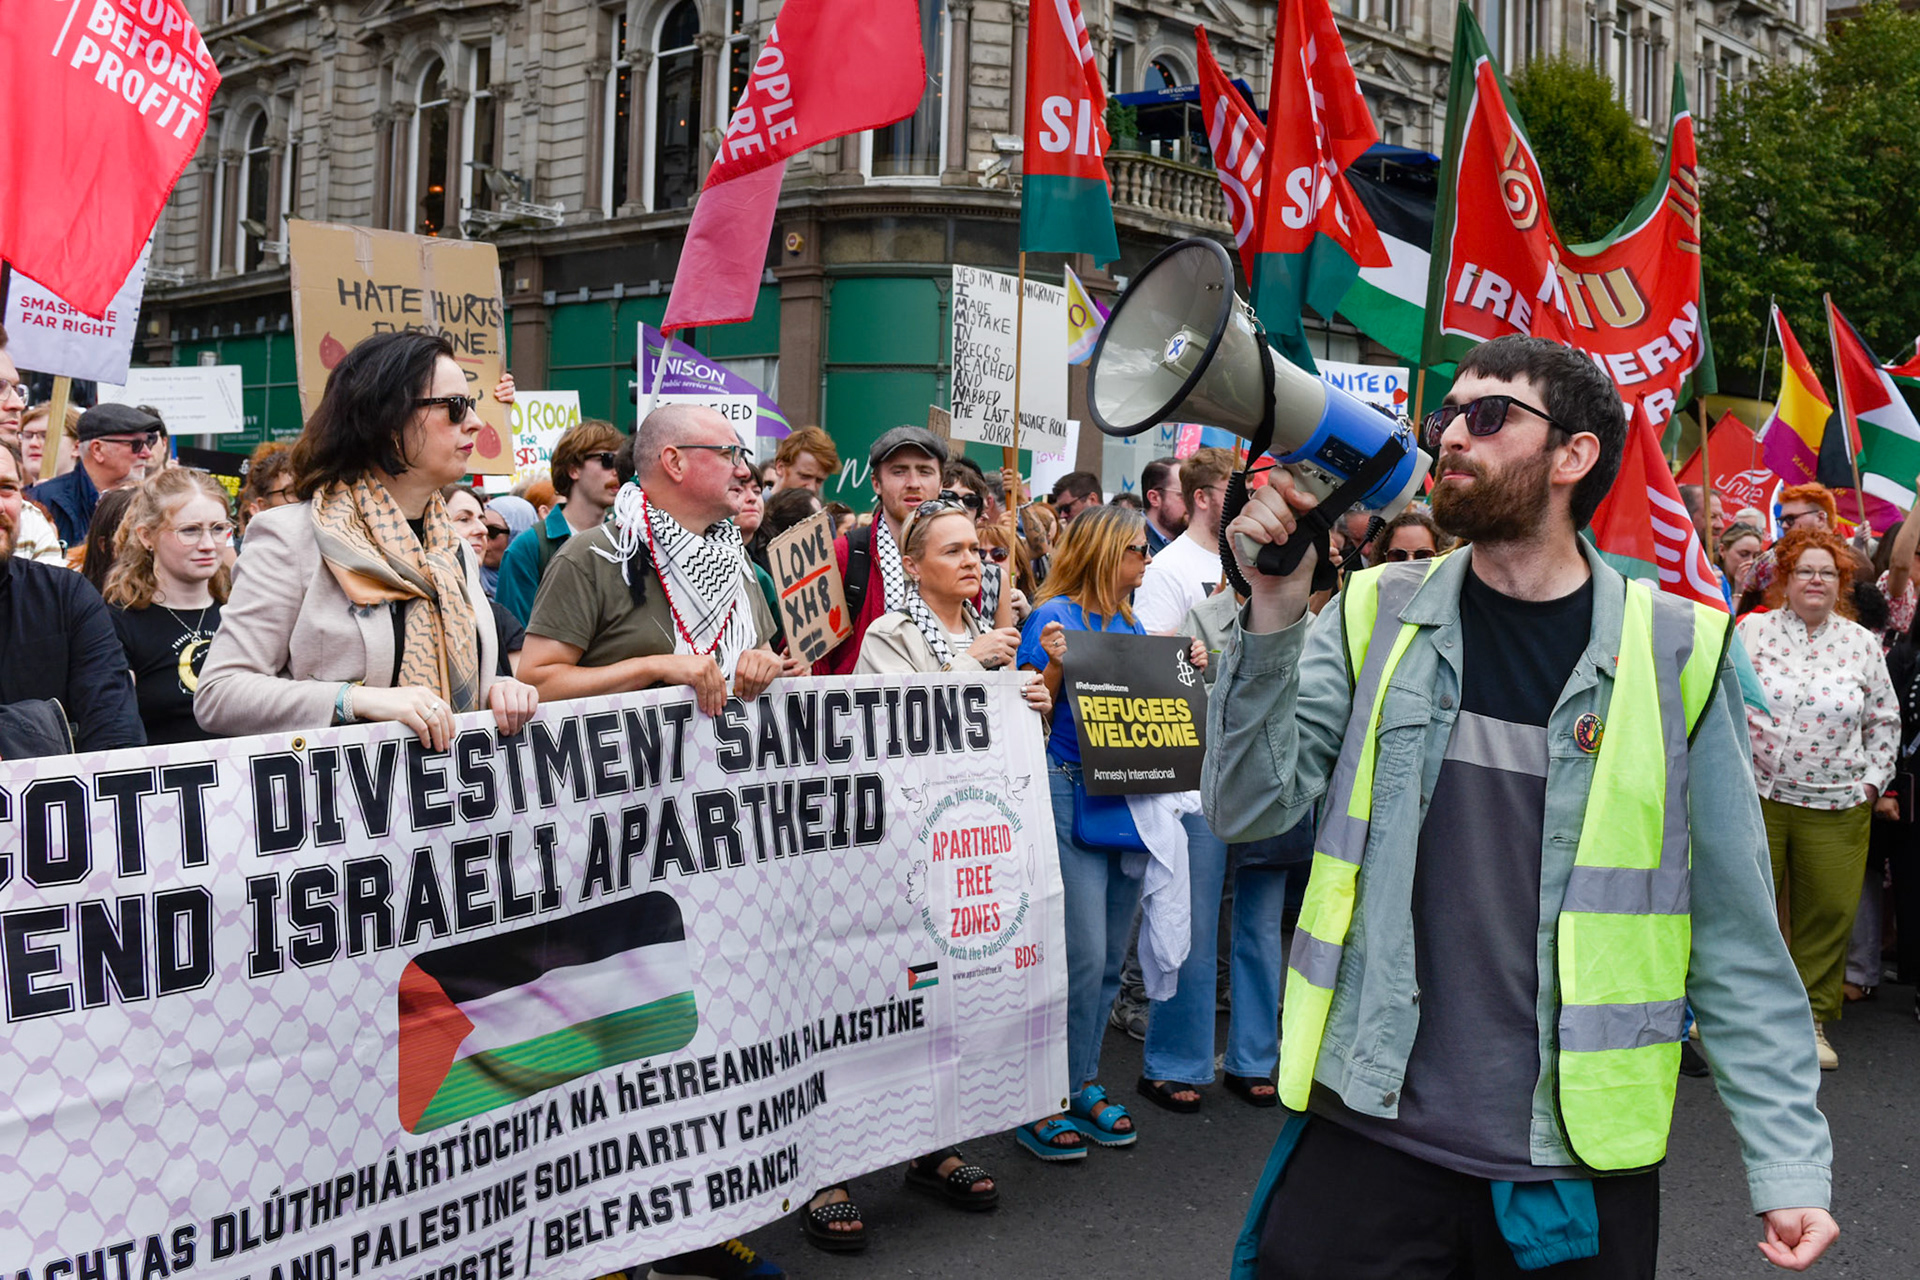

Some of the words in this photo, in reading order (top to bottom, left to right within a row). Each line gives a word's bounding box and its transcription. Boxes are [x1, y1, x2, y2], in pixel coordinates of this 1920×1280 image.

[87, 0, 206, 106] BEFORE
[70, 34, 199, 139] PROFIT
[753, 24, 798, 146] OPLE
[956, 266, 975, 285] YES
[979, 273, 994, 291] I'M
[999, 277, 1011, 297] AN
[20, 295, 79, 316] SMASH
[337, 277, 424, 313] HATE
[429, 288, 504, 328] HURTS
[955, 296, 992, 316] MADE
[22, 311, 58, 329] FAR
[62, 319, 116, 337] RIGHT
[953, 309, 1012, 335] MISTAKE
[953, 354, 1015, 382] REACHED
[953, 371, 983, 388] AND
[952, 385, 1001, 406] NABBED
[951, 401, 975, 420] THE
[983, 404, 1010, 424] LAST
[776, 523, 829, 589] LOVE
[1075, 681, 1129, 693] #RefugeesWelcome
[1077, 695, 1192, 723] REFUGEES
[1083, 722, 1200, 748] WELCOME
[248, 699, 695, 858] DIVESTMENT
[711, 683, 992, 775] SANCTIONS
[1094, 768, 1128, 782] Amnesty
[1127, 766, 1176, 781] International
[917, 825, 930, 845] For
[955, 785, 984, 807] justice
[984, 789, 998, 806] and
[996, 798, 1024, 834] equality
[932, 823, 1012, 863] APARTHEID
[0, 884, 215, 1024] END
[245, 821, 564, 980] ISRAELI
[577, 771, 887, 903] APARTHEID
[956, 864, 993, 899] FREE
[921, 905, 930, 918] in
[950, 902, 1000, 938] ZONES
[1015, 892, 1030, 925] people
[923, 917, 950, 956] solidarity
[982, 921, 1019, 958] Palestinian
[949, 945, 968, 961] with
[969, 947, 982, 961] the
[1015, 943, 1038, 970] BDS
[534, 1110, 728, 1202] SOLIDARITY
[210, 1098, 564, 1262] DLÚTHPHÁIRTÍOCHTA
[570, 1083, 608, 1129] NA
[544, 1177, 696, 1260] BELFAST
[704, 1143, 800, 1211] BRANCH
